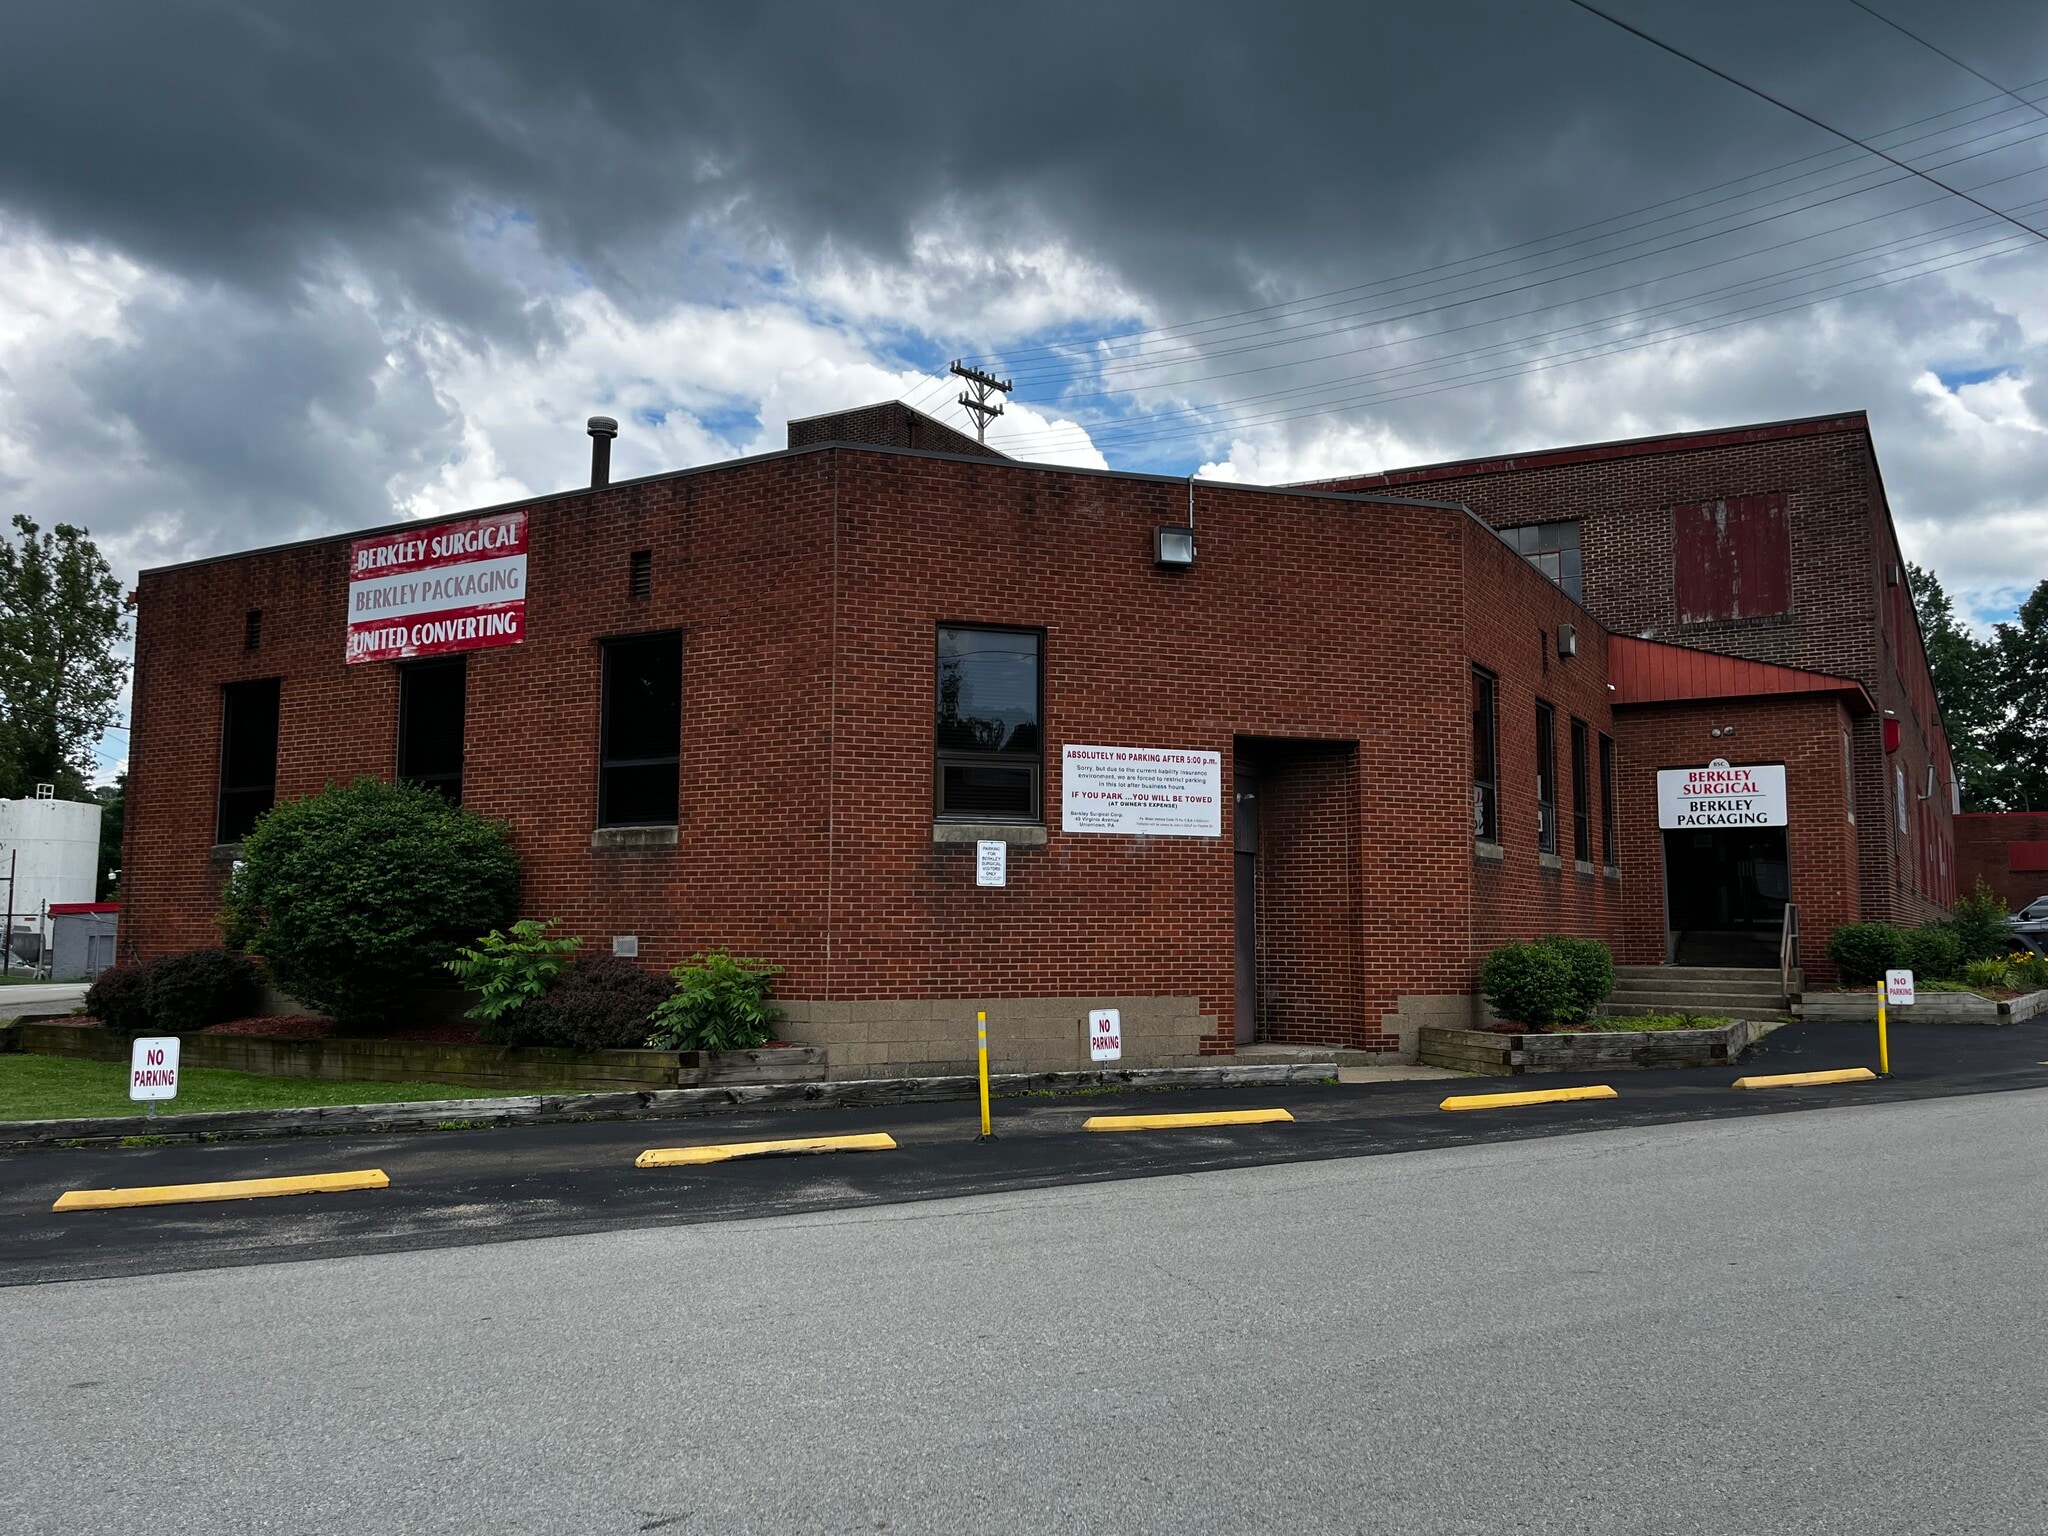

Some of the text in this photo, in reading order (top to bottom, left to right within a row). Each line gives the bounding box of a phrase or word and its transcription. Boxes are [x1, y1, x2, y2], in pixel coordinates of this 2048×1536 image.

[358, 524, 519, 571] BERKLEY SURGICAL
[356, 568, 518, 612] BERKLEY PACKAGING
[354, 612, 517, 654] UNITED CONVERTING
[1066, 750, 1114, 760] ABSOLUTELY
[1128, 754, 1160, 762] PARKING
[1162, 755, 1185, 763] AFTER
[1187, 756, 1201, 764] 5:00
[1689, 770, 1752, 782] BERKLEY
[1683, 782, 1759, 795] SURGICAL
[1690, 800, 1752, 812] BERKLEY
[1678, 812, 1768, 826] PACKAGING
[1099, 1019, 1110, 1032] NO
[1093, 1036, 1118, 1050] PARKING
[147, 1049, 164, 1066] NO
[134, 1069, 174, 1087] PARKING
